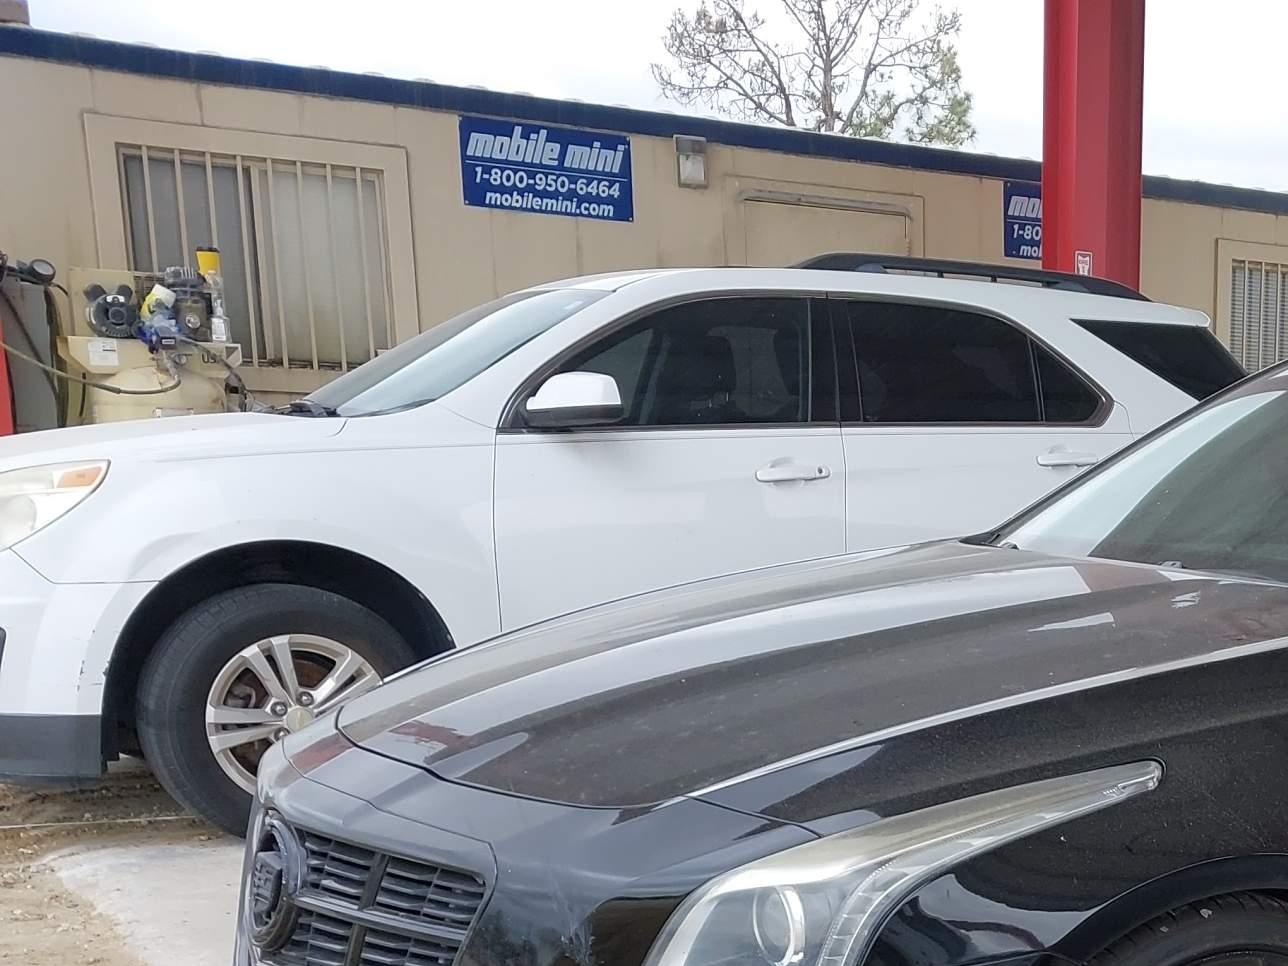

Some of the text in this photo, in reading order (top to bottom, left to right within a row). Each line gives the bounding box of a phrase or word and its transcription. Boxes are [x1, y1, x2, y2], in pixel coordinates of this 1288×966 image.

[466, 126, 625, 173] mobile mini
[474, 166, 620, 199] 1-800-950-6464
[485, 190, 614, 218] mobilemini.com
